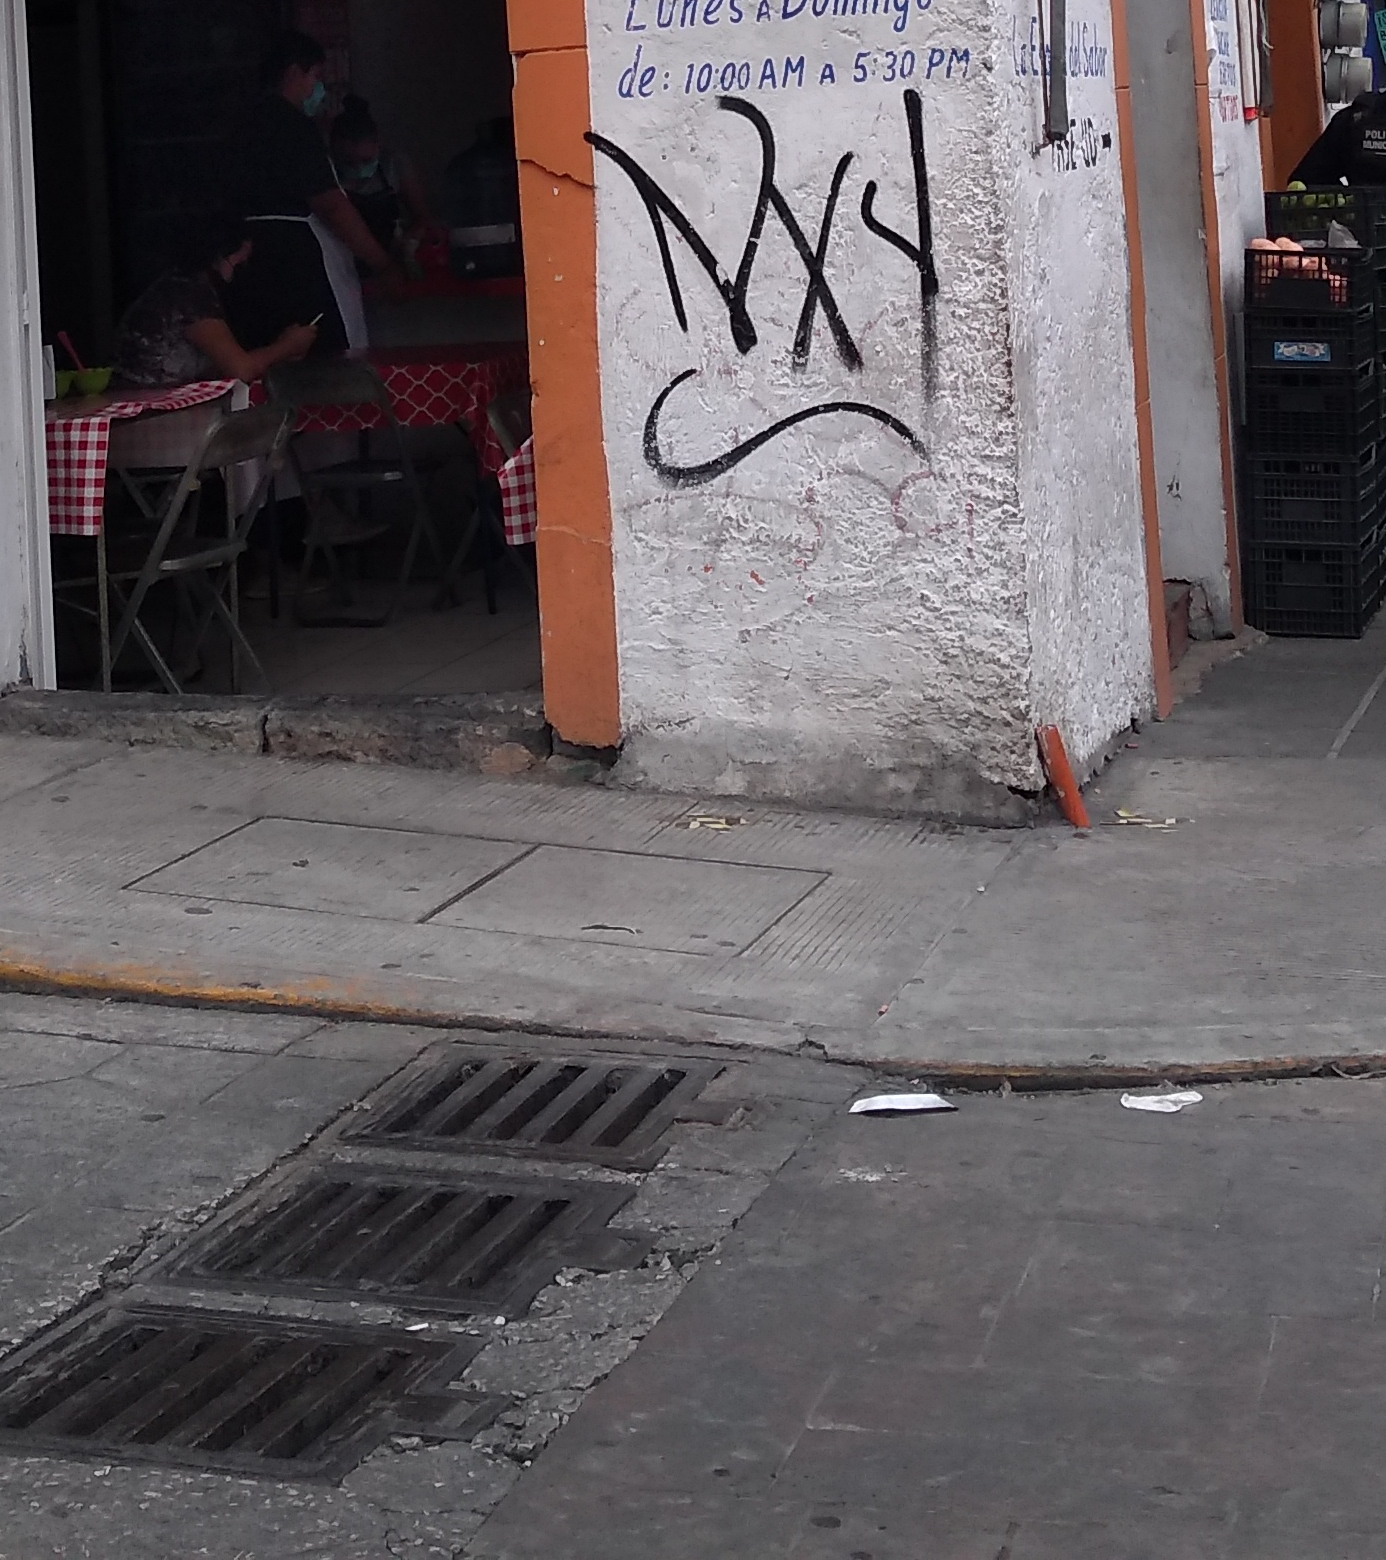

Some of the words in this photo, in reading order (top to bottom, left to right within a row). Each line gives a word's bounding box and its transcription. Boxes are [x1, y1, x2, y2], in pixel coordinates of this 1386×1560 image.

[758, 56, 805, 90] AM
[853, 49, 914, 84] 5:30
[925, 47, 972, 80] PM
